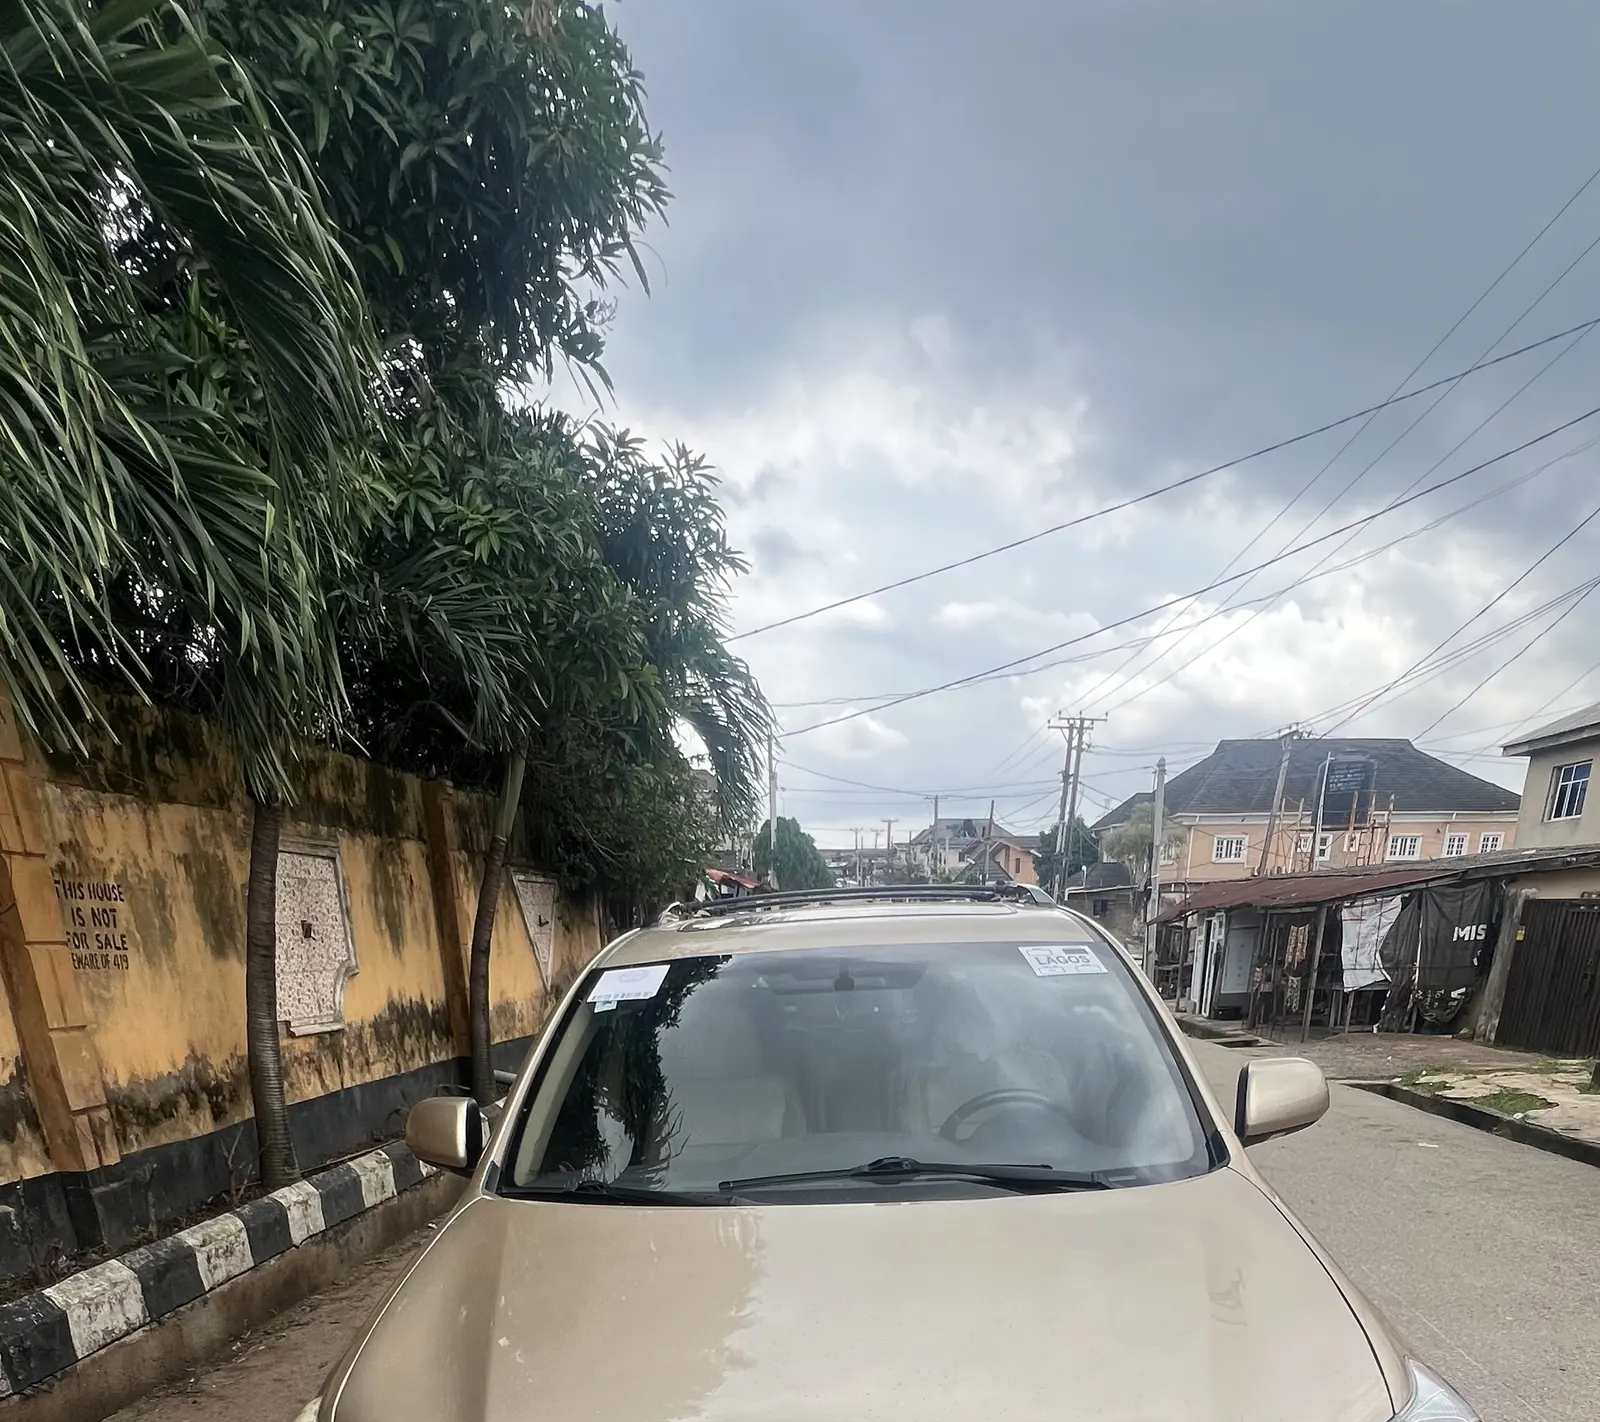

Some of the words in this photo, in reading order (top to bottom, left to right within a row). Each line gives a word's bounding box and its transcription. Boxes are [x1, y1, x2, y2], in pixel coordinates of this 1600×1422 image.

[54, 879, 85, 900] THIS
[87, 882, 125, 902] HOUSE
[70, 906, 86, 927] IS
[91, 906, 117, 929] NOT
[95, 933, 129, 951] SALE
[71, 952, 100, 970] EWARE
[100, 954, 111, 970] OF
[114, 954, 129, 971] 419
[1036, 955, 1090, 965] LAGOS
